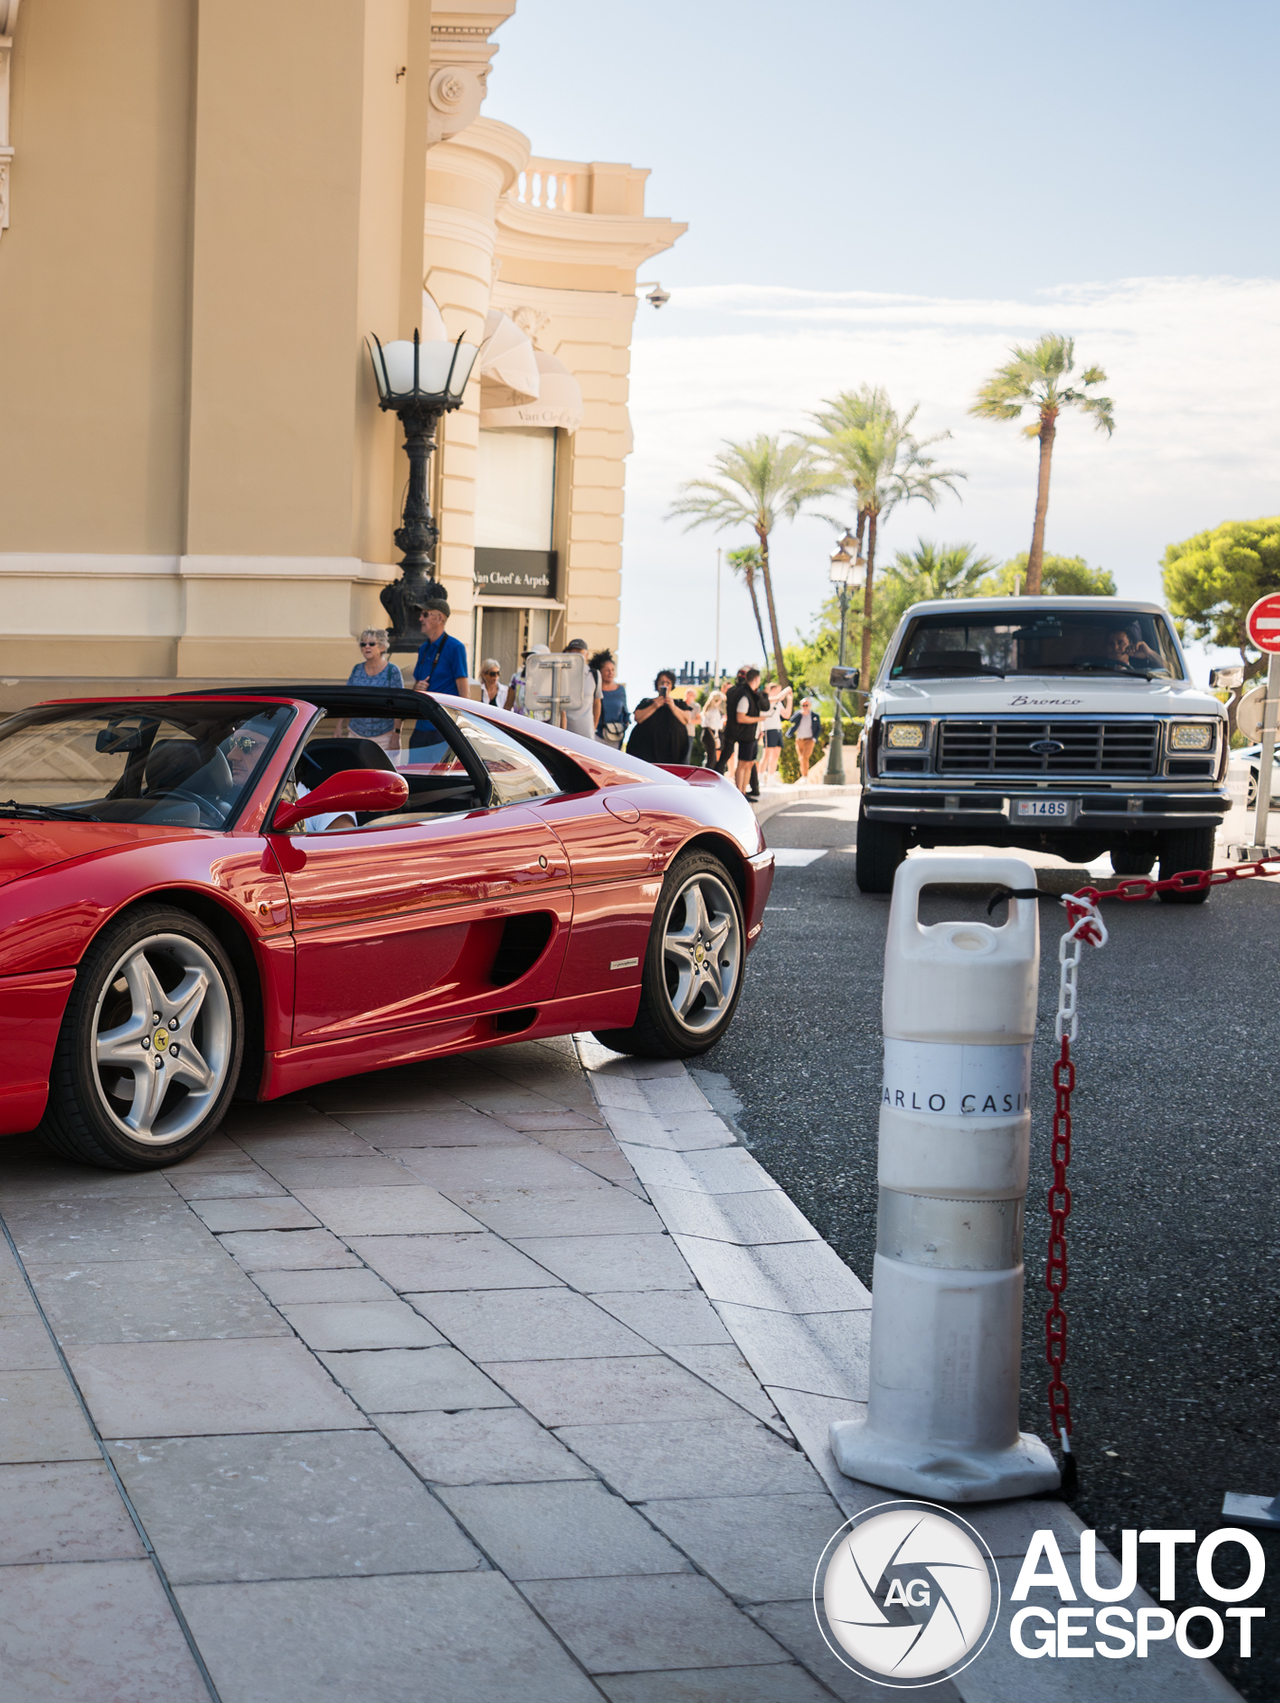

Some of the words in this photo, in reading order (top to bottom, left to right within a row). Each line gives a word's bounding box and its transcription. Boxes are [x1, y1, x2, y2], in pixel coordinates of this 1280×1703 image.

[490, 571, 514, 584] Cleef
[515, 574, 522, 585] &
[523, 573, 550, 589] Arpels
[1008, 695, 1084, 706] Bronco
[1032, 803, 1065, 815] 148S
